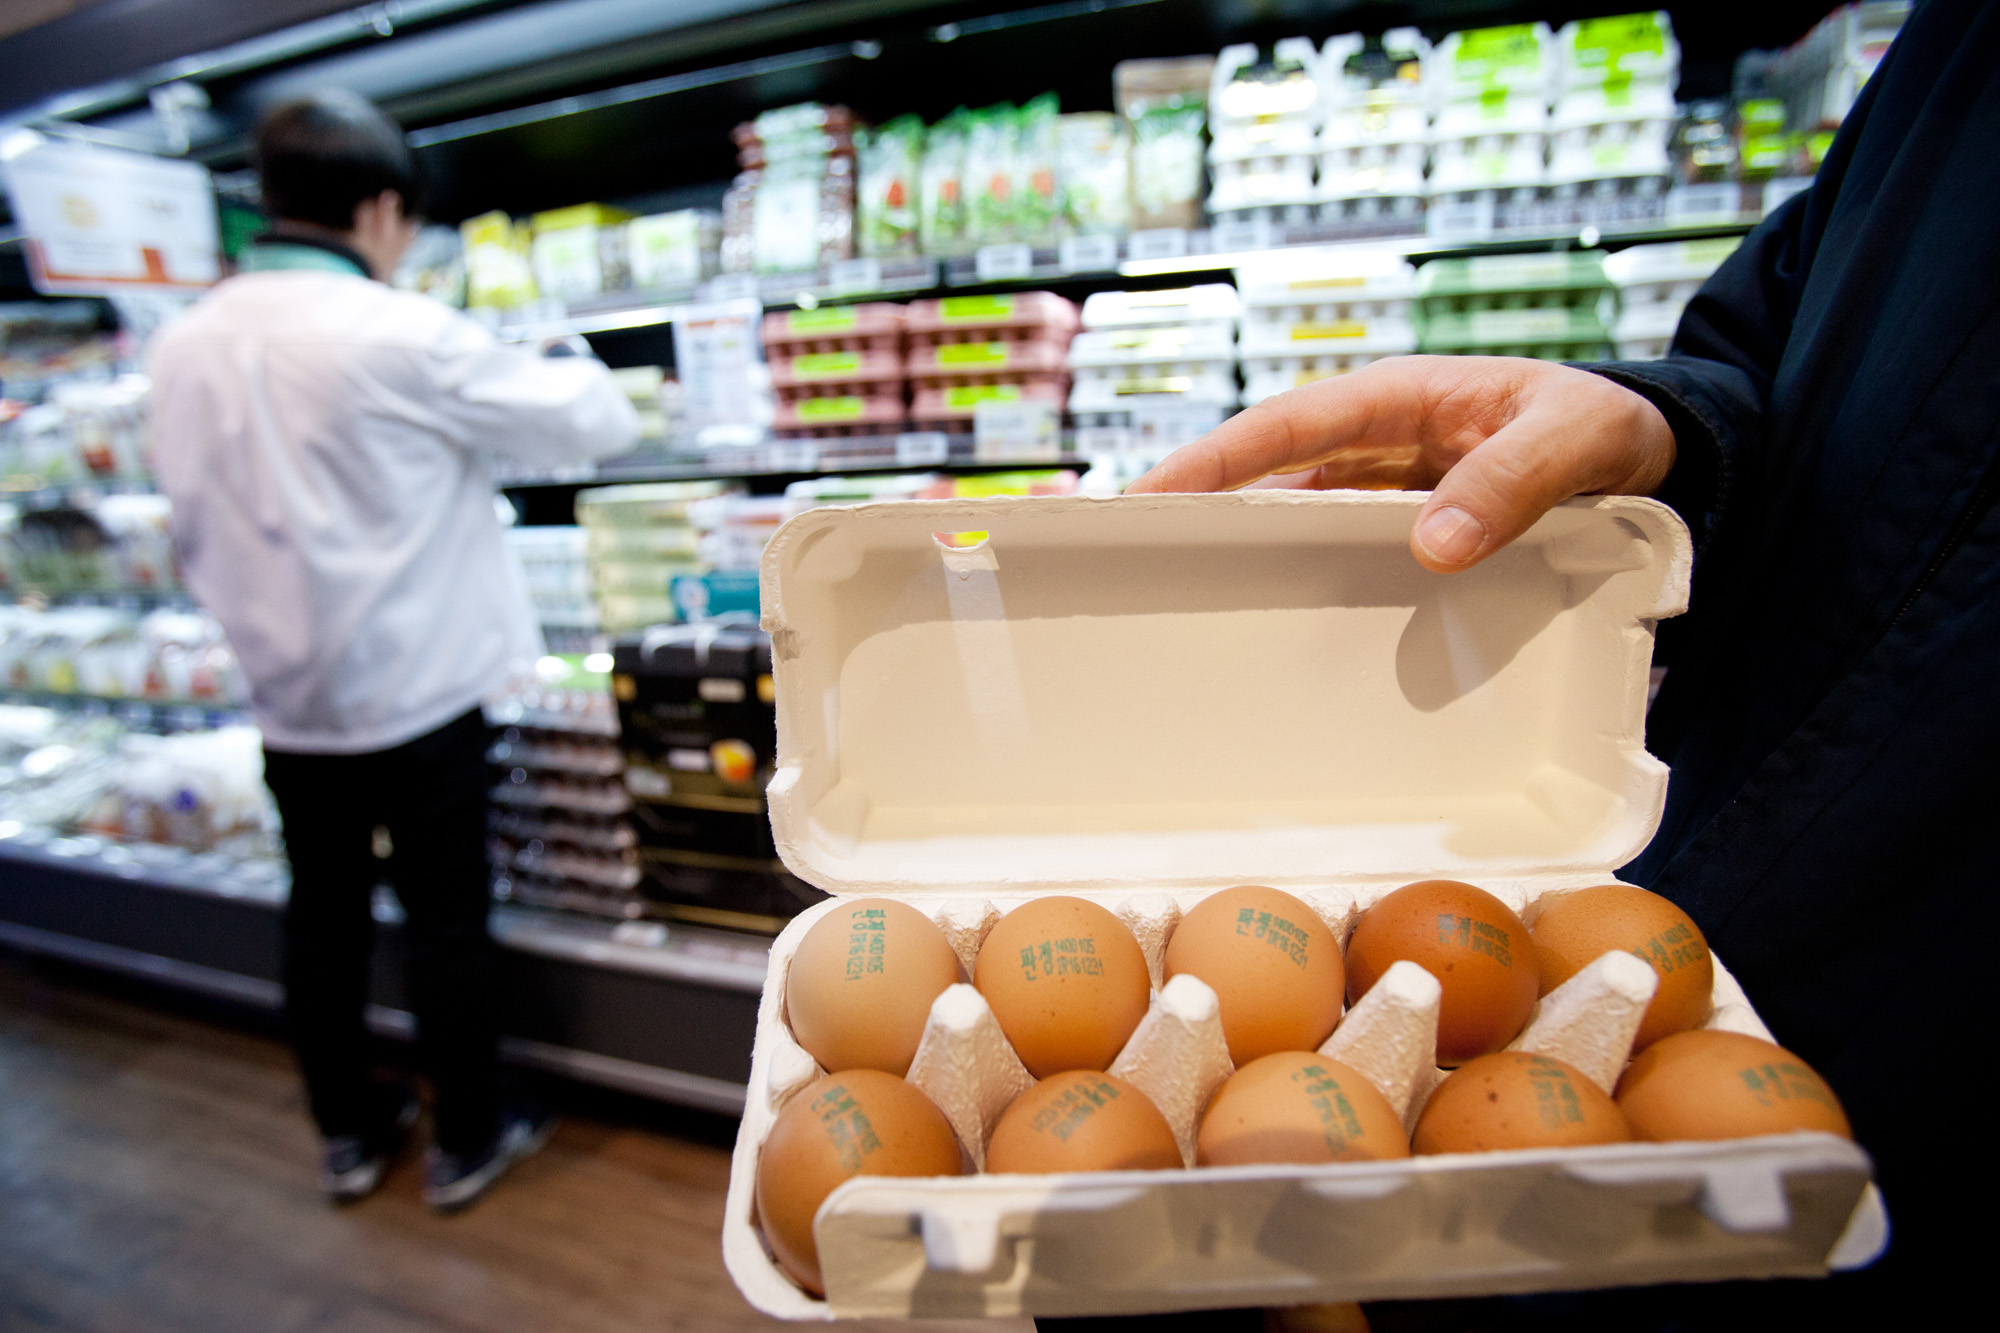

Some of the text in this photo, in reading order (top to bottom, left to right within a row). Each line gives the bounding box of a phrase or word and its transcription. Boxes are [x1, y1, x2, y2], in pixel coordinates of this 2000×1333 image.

[852, 909, 886, 931] 판정
[1236, 908, 1272, 938] 판정
[1020, 940, 1053, 981] 판정
